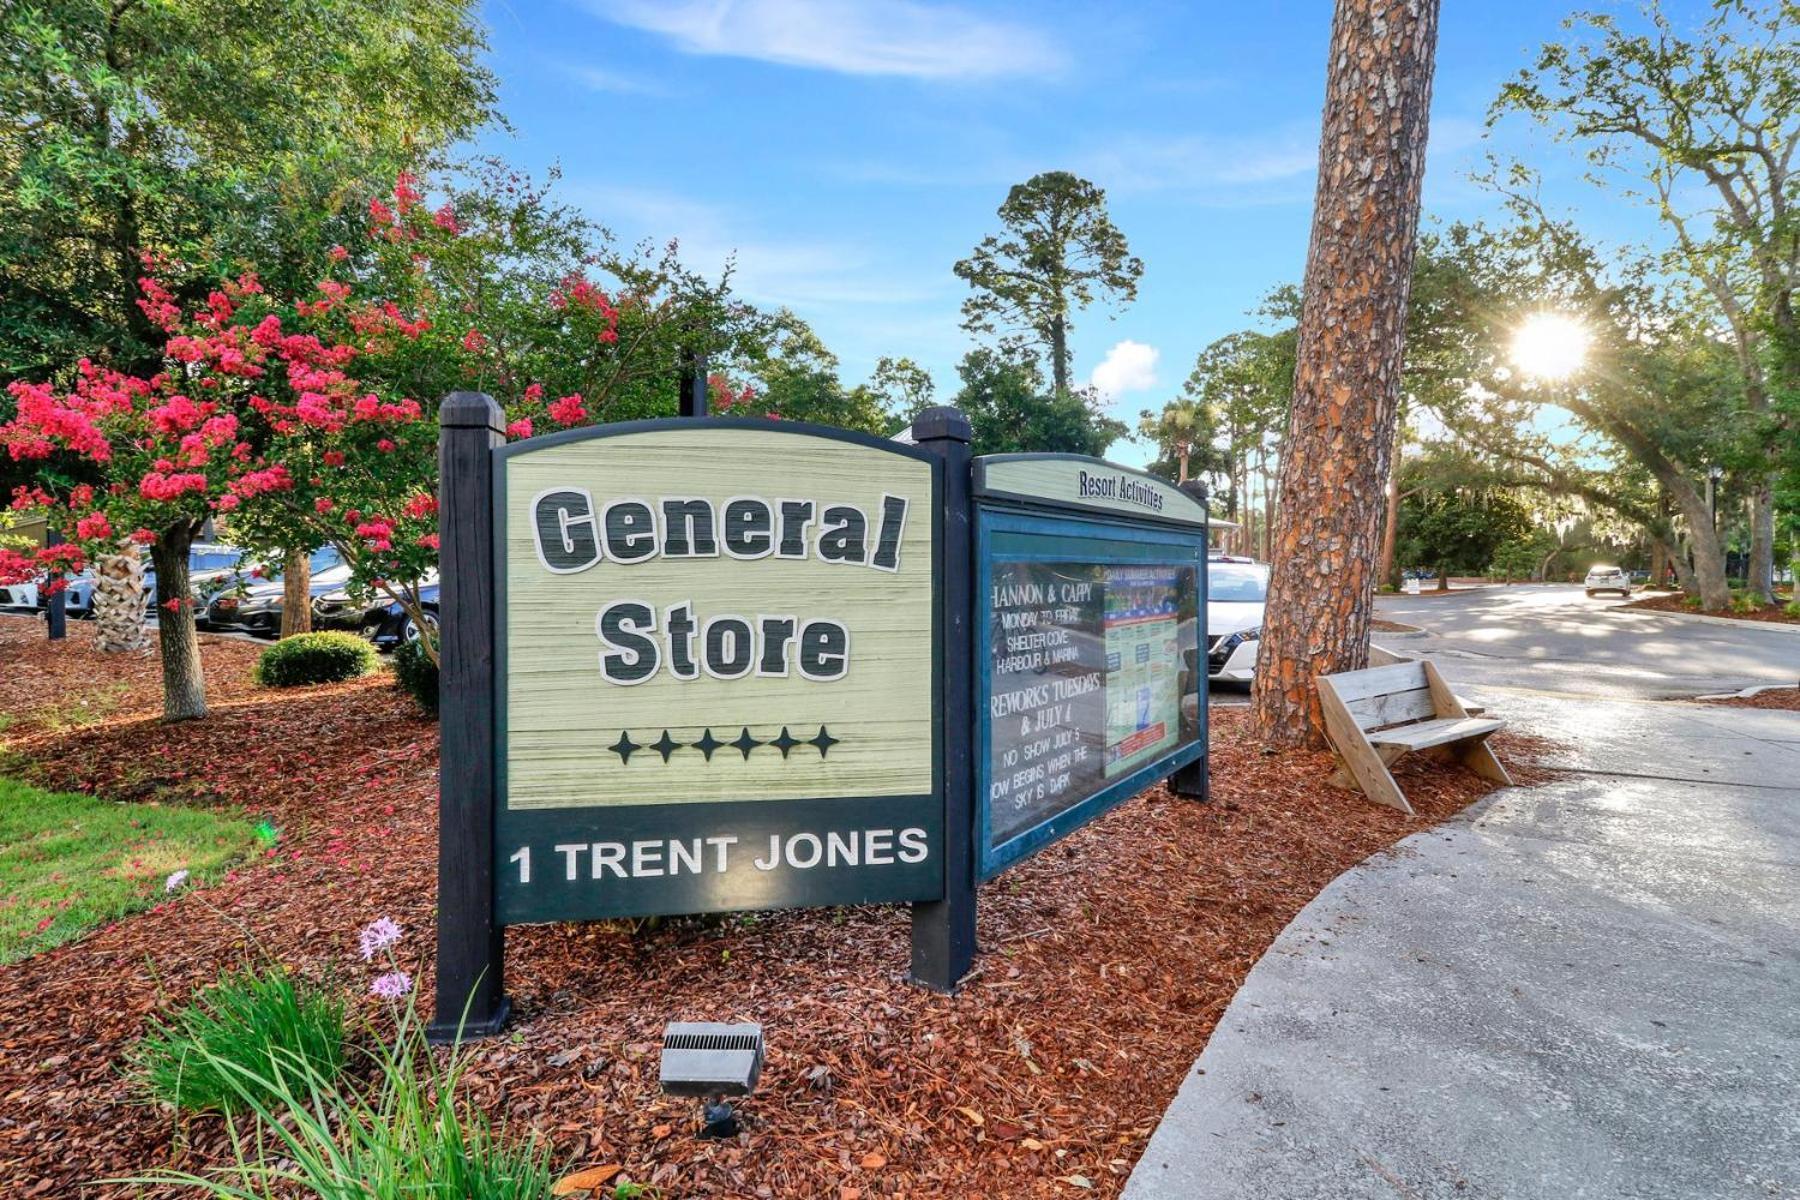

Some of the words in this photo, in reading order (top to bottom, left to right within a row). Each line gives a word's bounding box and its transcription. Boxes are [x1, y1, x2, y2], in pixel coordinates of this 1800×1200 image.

[1079, 470, 1116, 497] Resort
[1119, 475, 1163, 510] Activities
[531, 487, 908, 573] General
[991, 583, 1043, 608] HANNON
[1047, 583, 1056, 603] &
[1061, 583, 1092, 603] CAPPY
[597, 600, 850, 686] Store
[1007, 633, 1046, 653] SHELTER
[1046, 629, 1069, 646] COVE
[996, 652, 1042, 675] HARBOUR
[990, 684, 1049, 719] REWORKS
[1052, 672, 1100, 702] TUESDAYS
[1021, 715, 1031, 736] &
[1034, 704, 1063, 732] JULY
[1003, 749, 1018, 768] NO
[1024, 737, 1051, 760] SHOW
[1053, 730, 1072, 749] JULY
[1013, 763, 1044, 789] BEGINS
[1047, 752, 1071, 774] WHEN
[1073, 745, 1088, 764] THE
[1014, 788, 1033, 810] SKY
[1050, 772, 1071, 794] DARK
[509, 846, 530, 883] 1
[554, 837, 738, 881] TRENT
[754, 827, 929, 871] JONES
